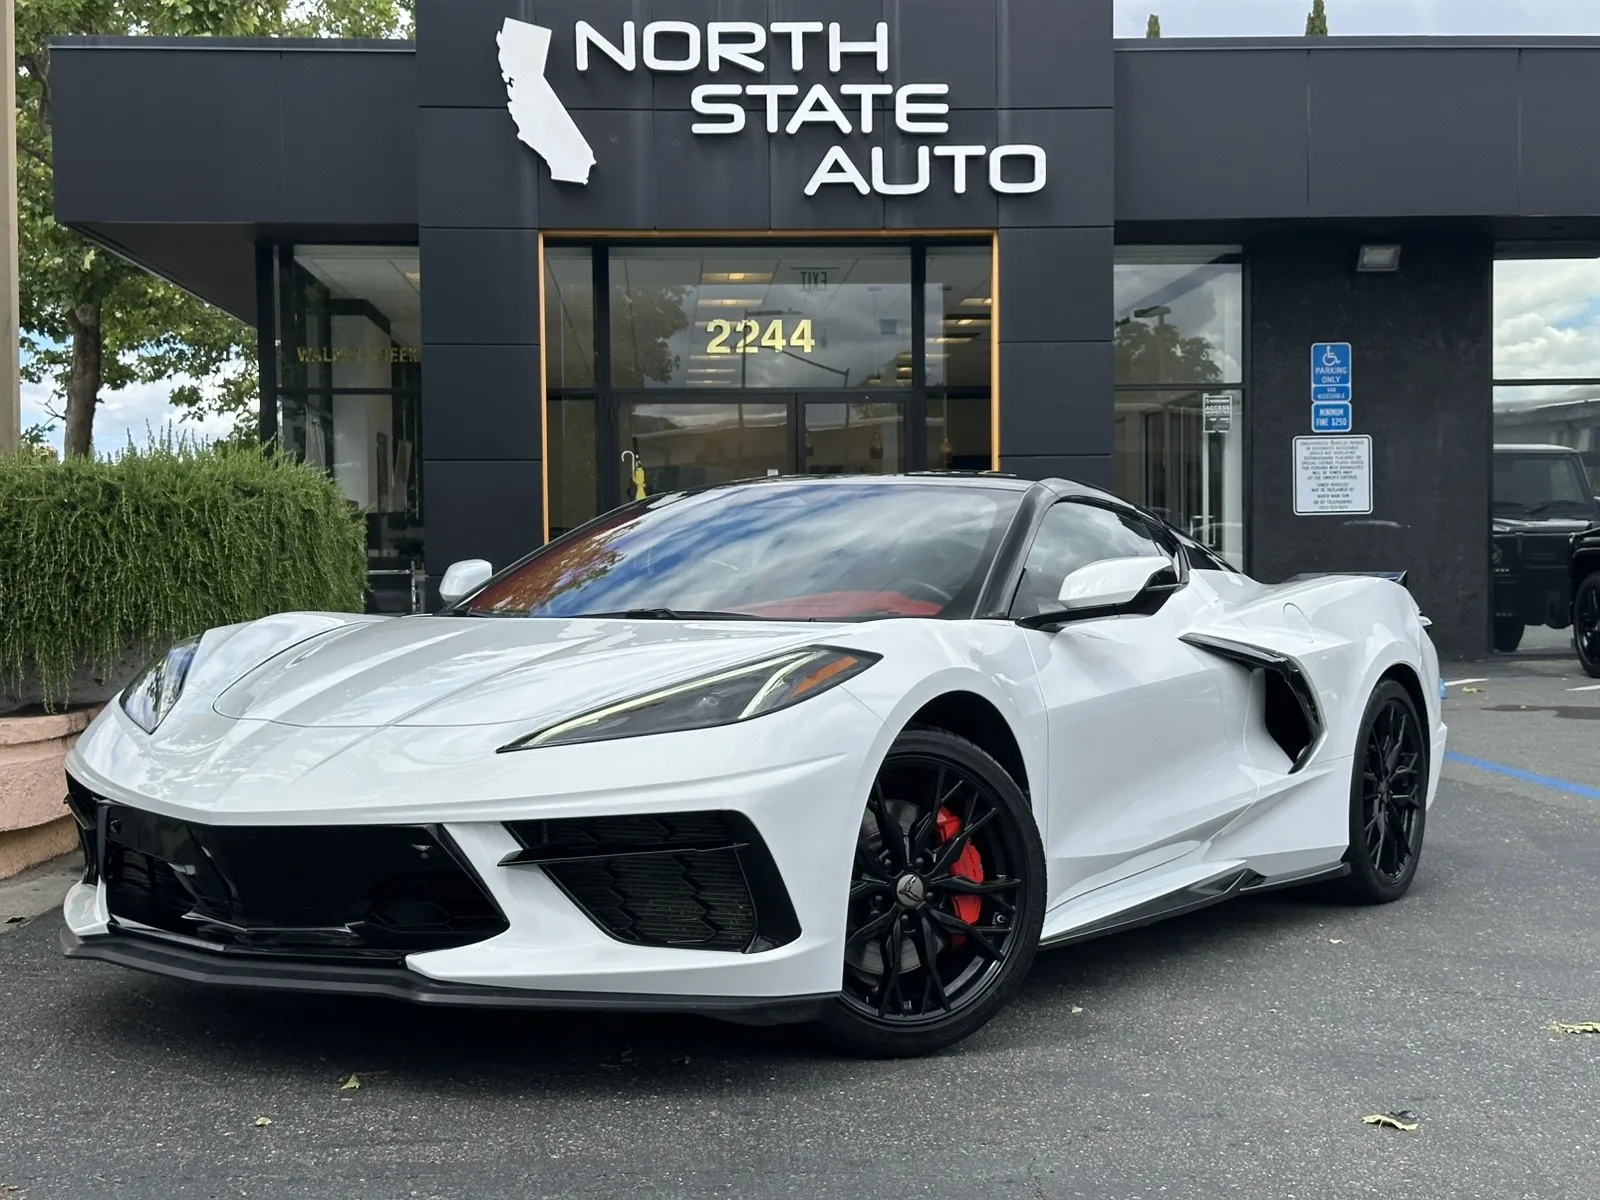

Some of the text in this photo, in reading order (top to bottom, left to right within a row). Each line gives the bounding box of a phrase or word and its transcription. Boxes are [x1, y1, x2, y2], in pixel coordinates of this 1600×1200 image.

[575, 20, 888, 72] NORTH
[691, 83, 949, 134] STATE
[804, 144, 1047, 195] AUTO
[706, 319, 815, 353] 2244
[1316, 418, 1347, 426] FINE $250
